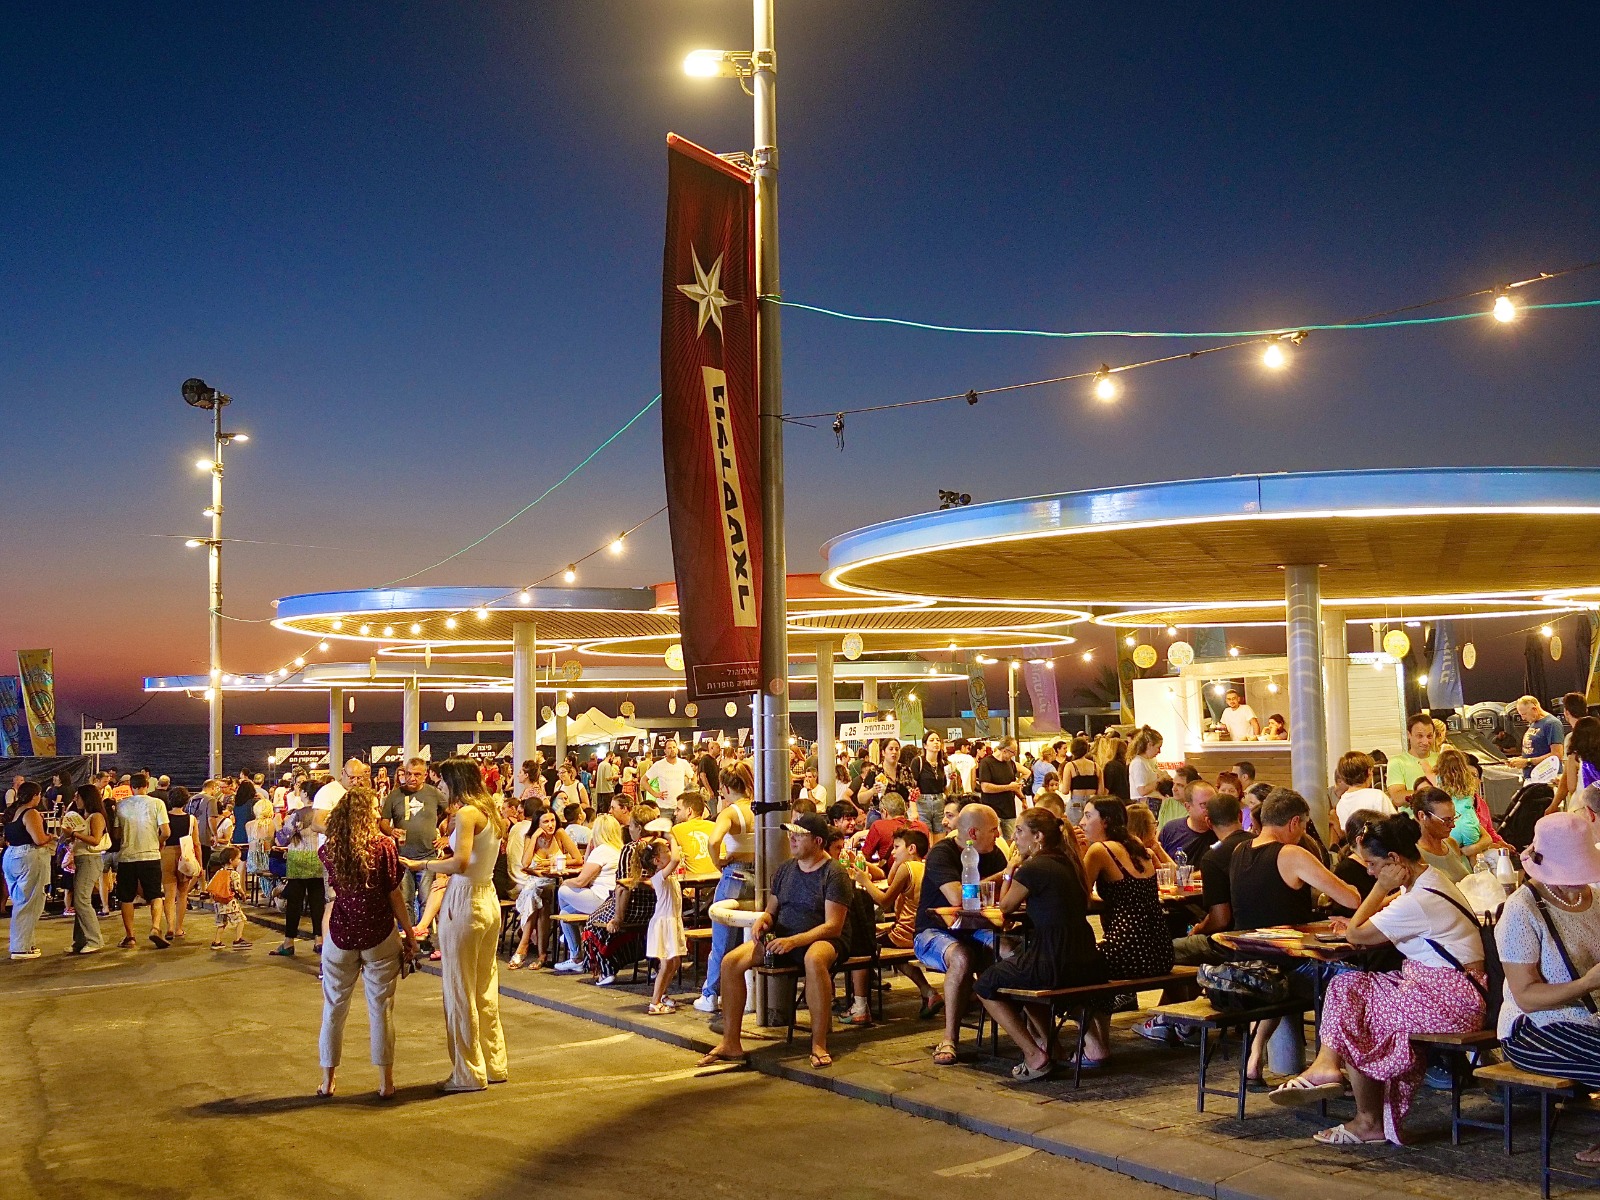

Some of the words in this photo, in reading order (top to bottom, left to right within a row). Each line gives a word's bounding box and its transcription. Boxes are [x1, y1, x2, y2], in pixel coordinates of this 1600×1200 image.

[84, 731, 114, 741] יציאת
[848, 726, 857, 736] 25
[84, 742, 114, 752] חירום
